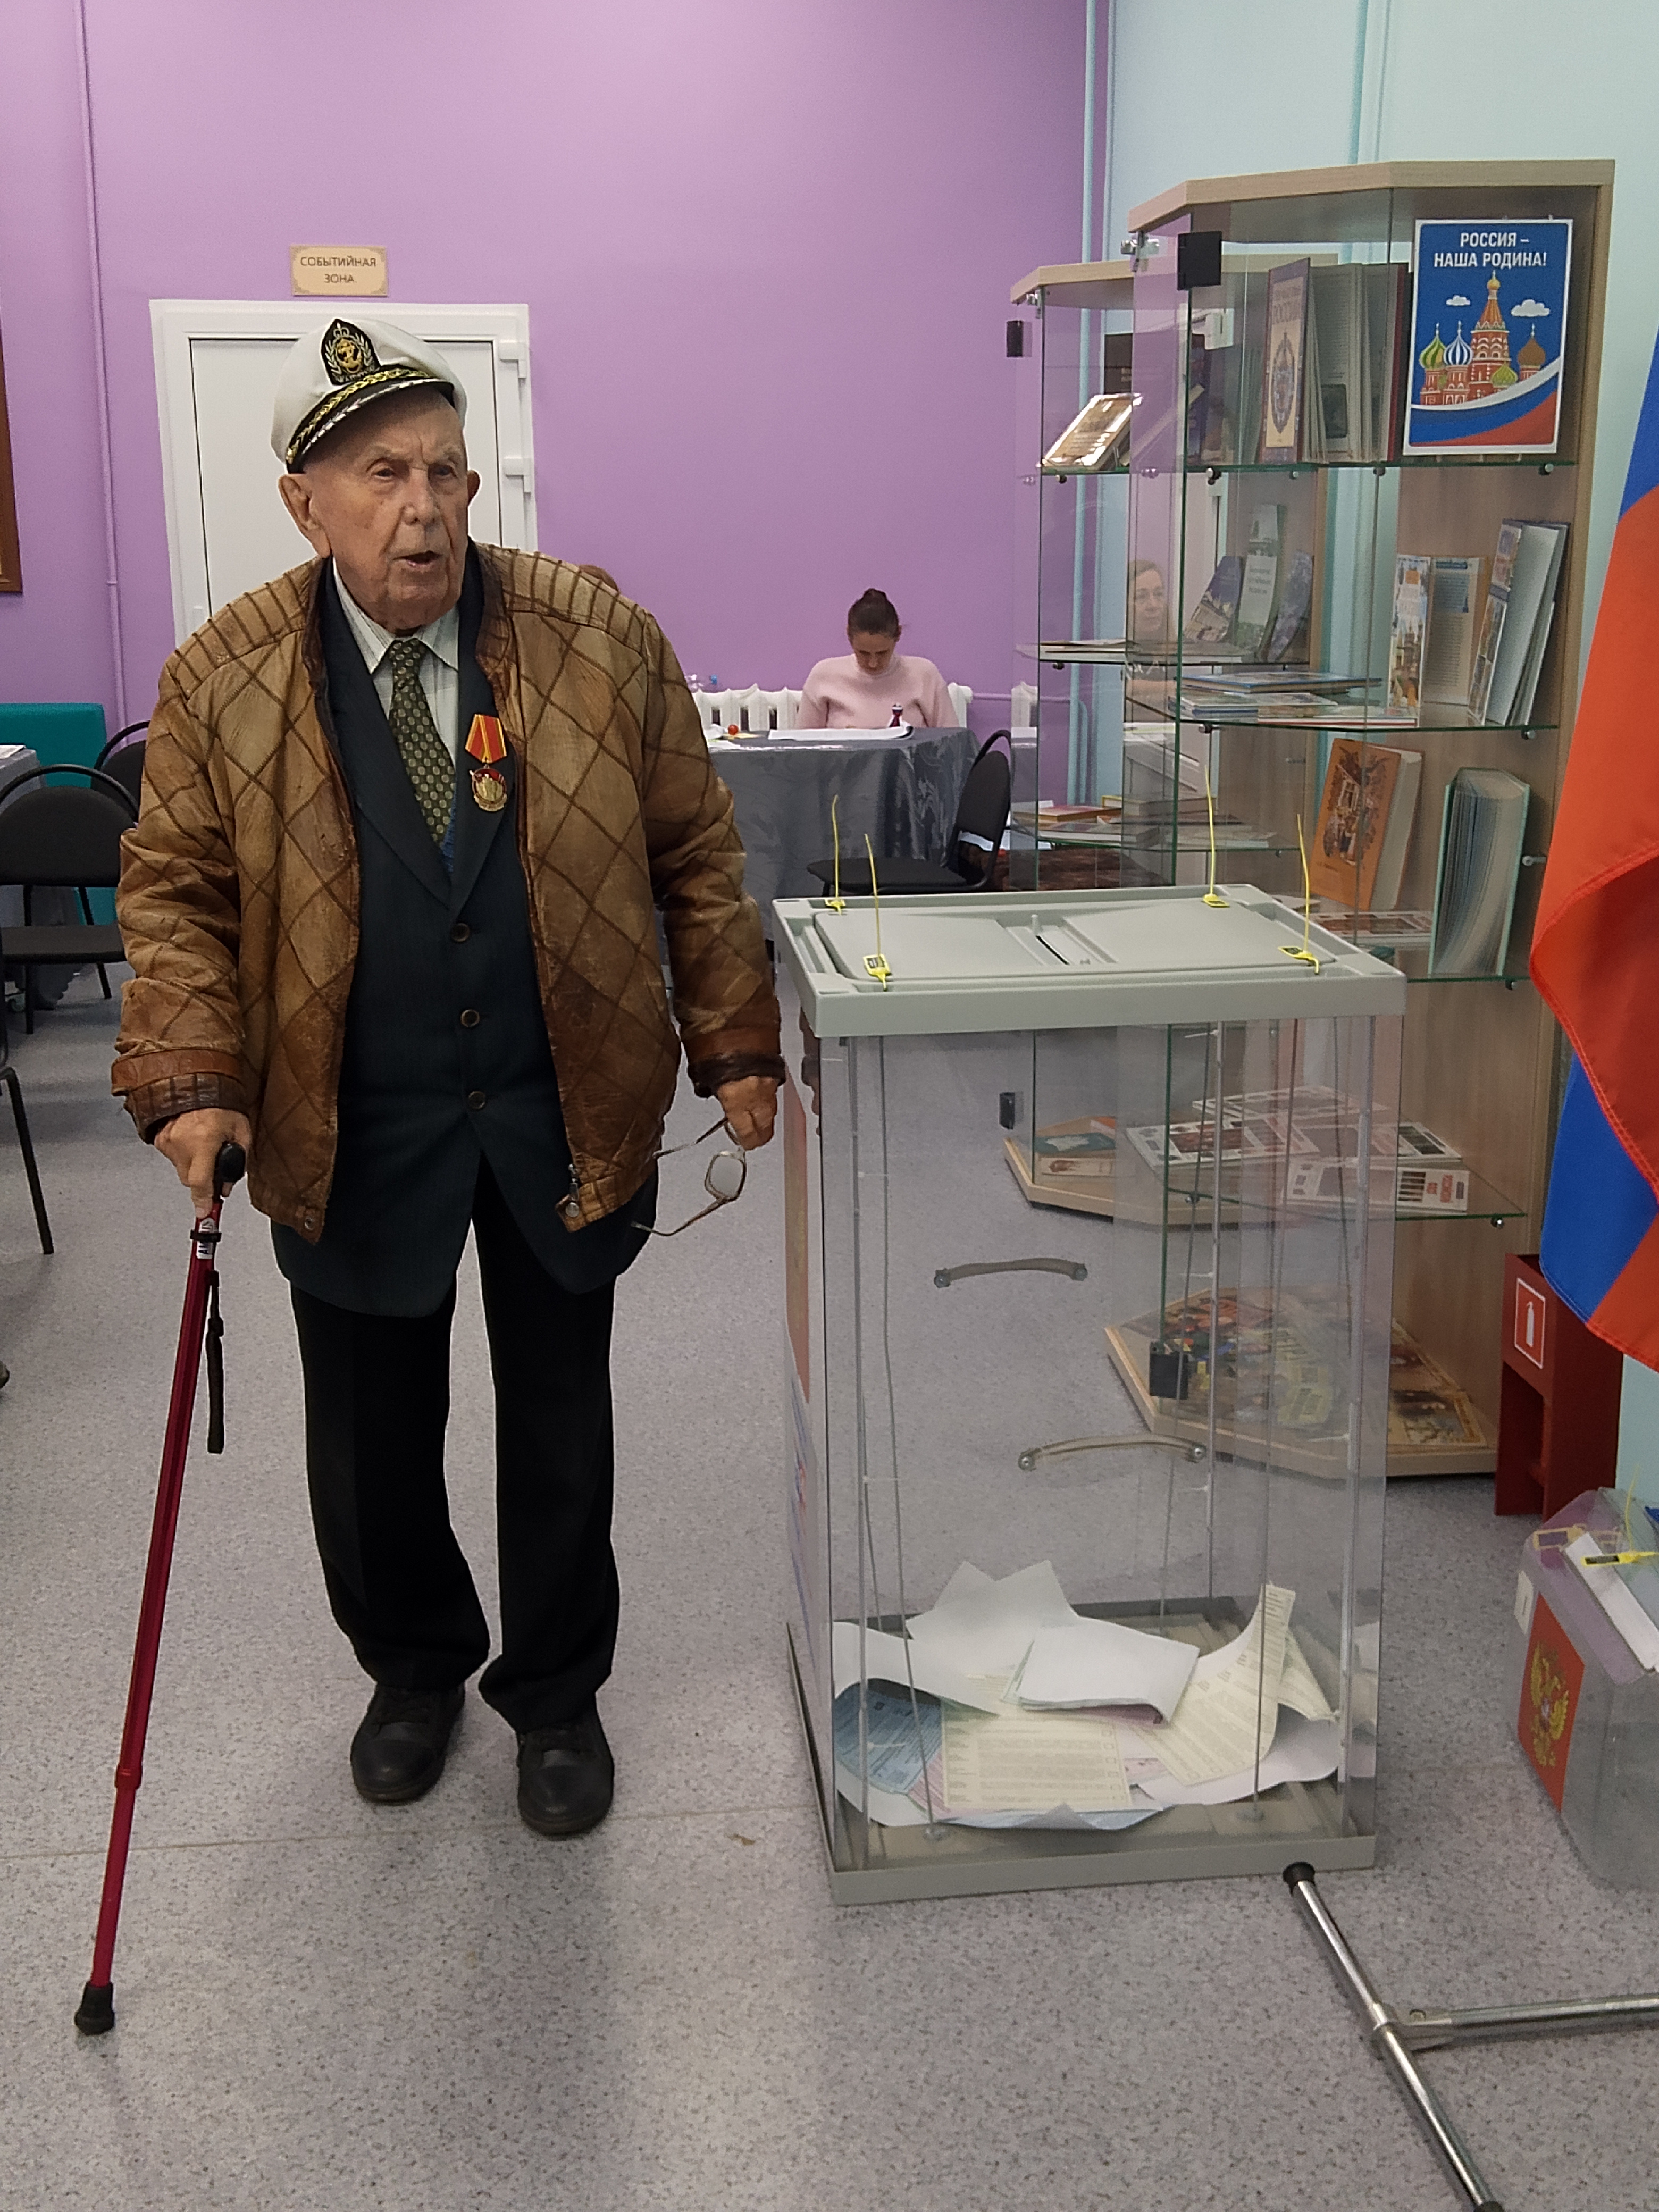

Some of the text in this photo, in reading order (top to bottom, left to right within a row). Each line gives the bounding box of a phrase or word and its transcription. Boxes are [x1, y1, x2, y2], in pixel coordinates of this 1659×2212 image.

[1460, 232, 1516, 247] РОССИЯ
[300, 255, 376, 267] СОБЫТИЙНАЯ
[1434, 251, 1547, 270] НАША РОДИНА!
[324, 273, 355, 283] ЗОНА
